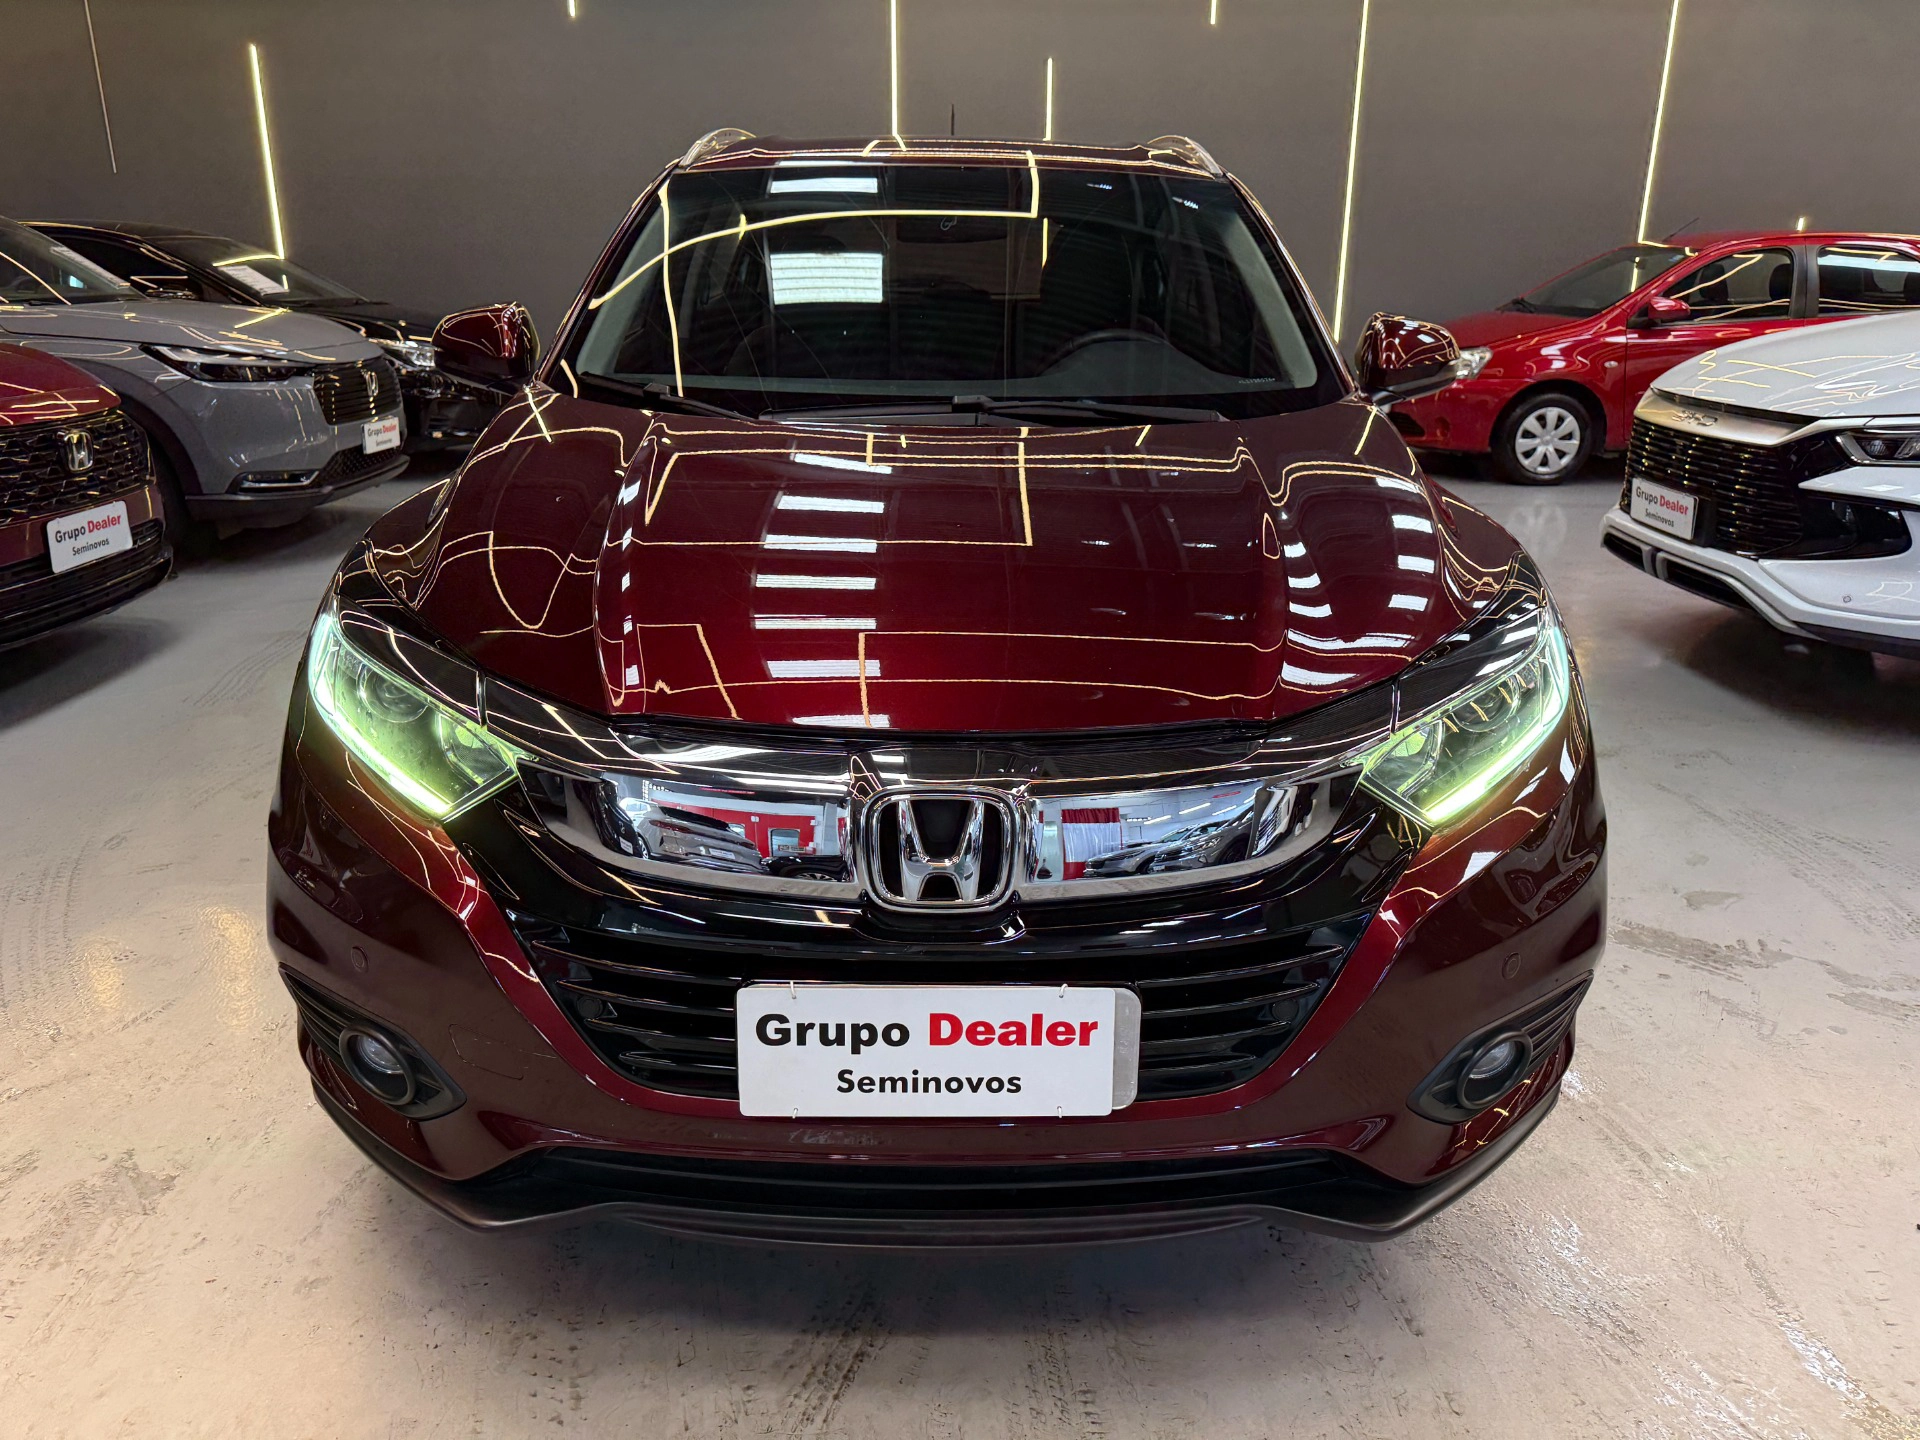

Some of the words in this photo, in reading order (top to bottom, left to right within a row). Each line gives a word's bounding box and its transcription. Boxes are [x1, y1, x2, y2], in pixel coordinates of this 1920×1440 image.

[1636, 486, 1659, 505] Grupo
[1659, 495, 1689, 515] Dealer
[55, 526, 86, 544] Grupo
[87, 515, 122, 534] Dealer
[1645, 508, 1675, 528] Seminovos
[72, 538, 110, 556] Seminovos
[755, 1013, 910, 1054] Grupo
[929, 1012, 1099, 1047] Dealer
[836, 1069, 1022, 1094] Seminovos
